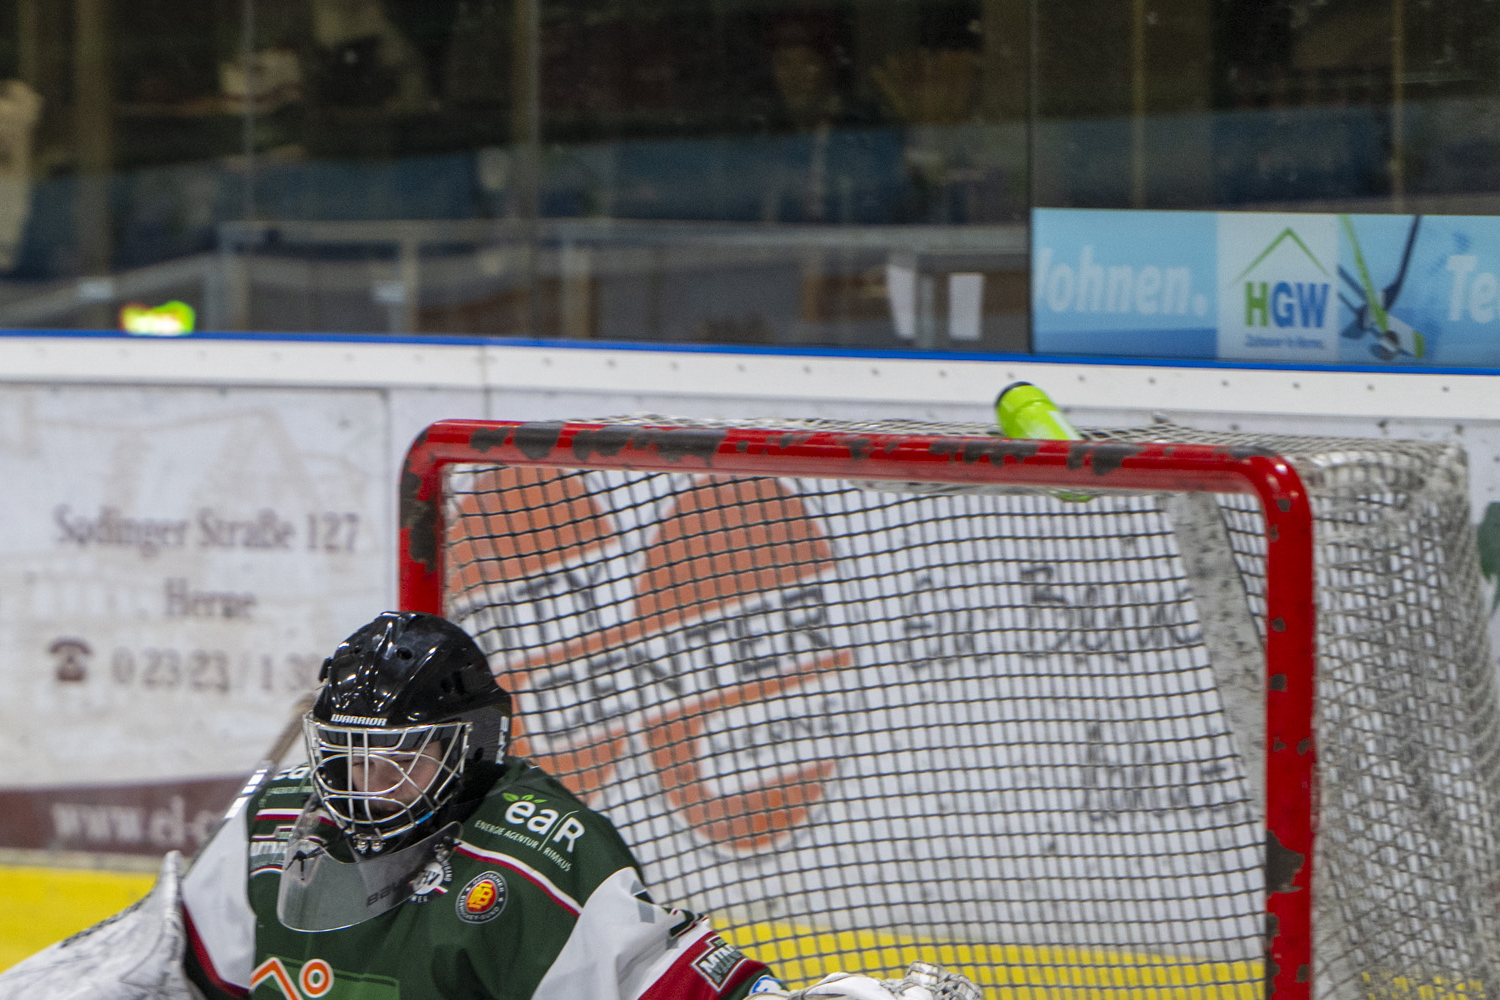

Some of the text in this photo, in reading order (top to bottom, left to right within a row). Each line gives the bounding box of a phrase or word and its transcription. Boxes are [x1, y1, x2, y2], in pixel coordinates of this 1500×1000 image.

[1244, 281, 1329, 329] HGW
[306, 512, 360, 552] 127
[530, 583, 836, 742] CENTER
[330, 714, 388, 727] WARRIOR
[474, 819, 573, 873] ENERGIE AGENTUR RIMKUS
[504, 800, 585, 854] eaR
